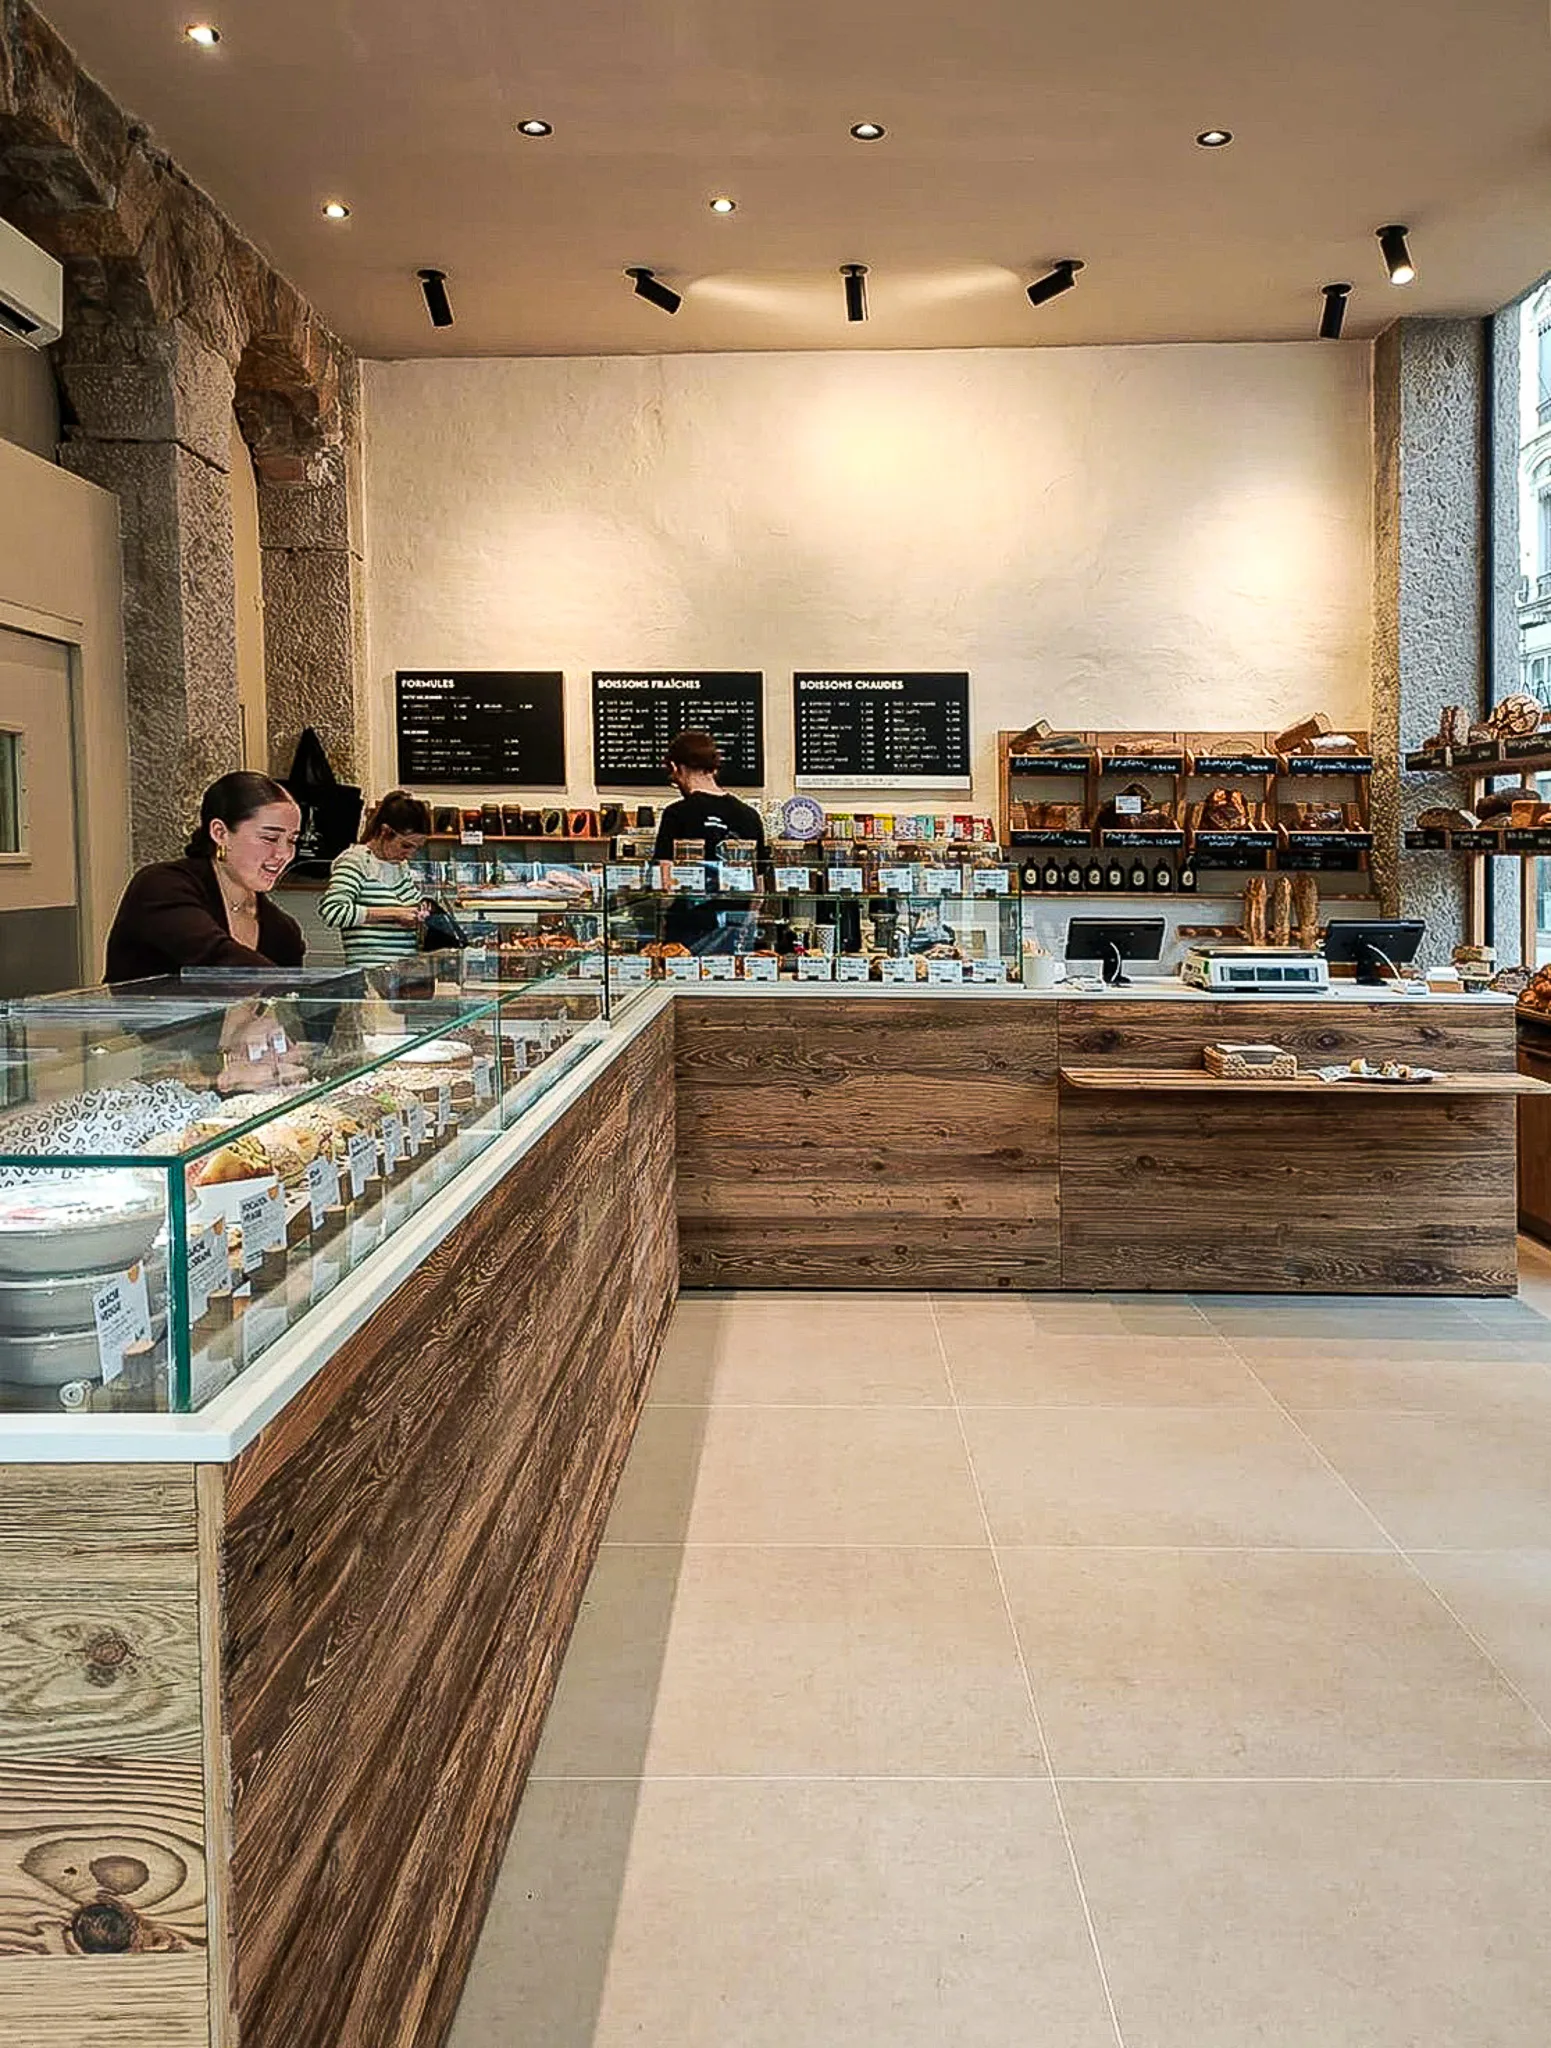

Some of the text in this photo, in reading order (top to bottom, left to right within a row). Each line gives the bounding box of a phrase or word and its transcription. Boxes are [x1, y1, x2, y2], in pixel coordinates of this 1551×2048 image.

[401, 679, 455, 689] FORMULES
[598, 677, 702, 689] BOISSONS FRAÎCHES
[800, 680, 904, 690] BOISSONS CHAUDES
